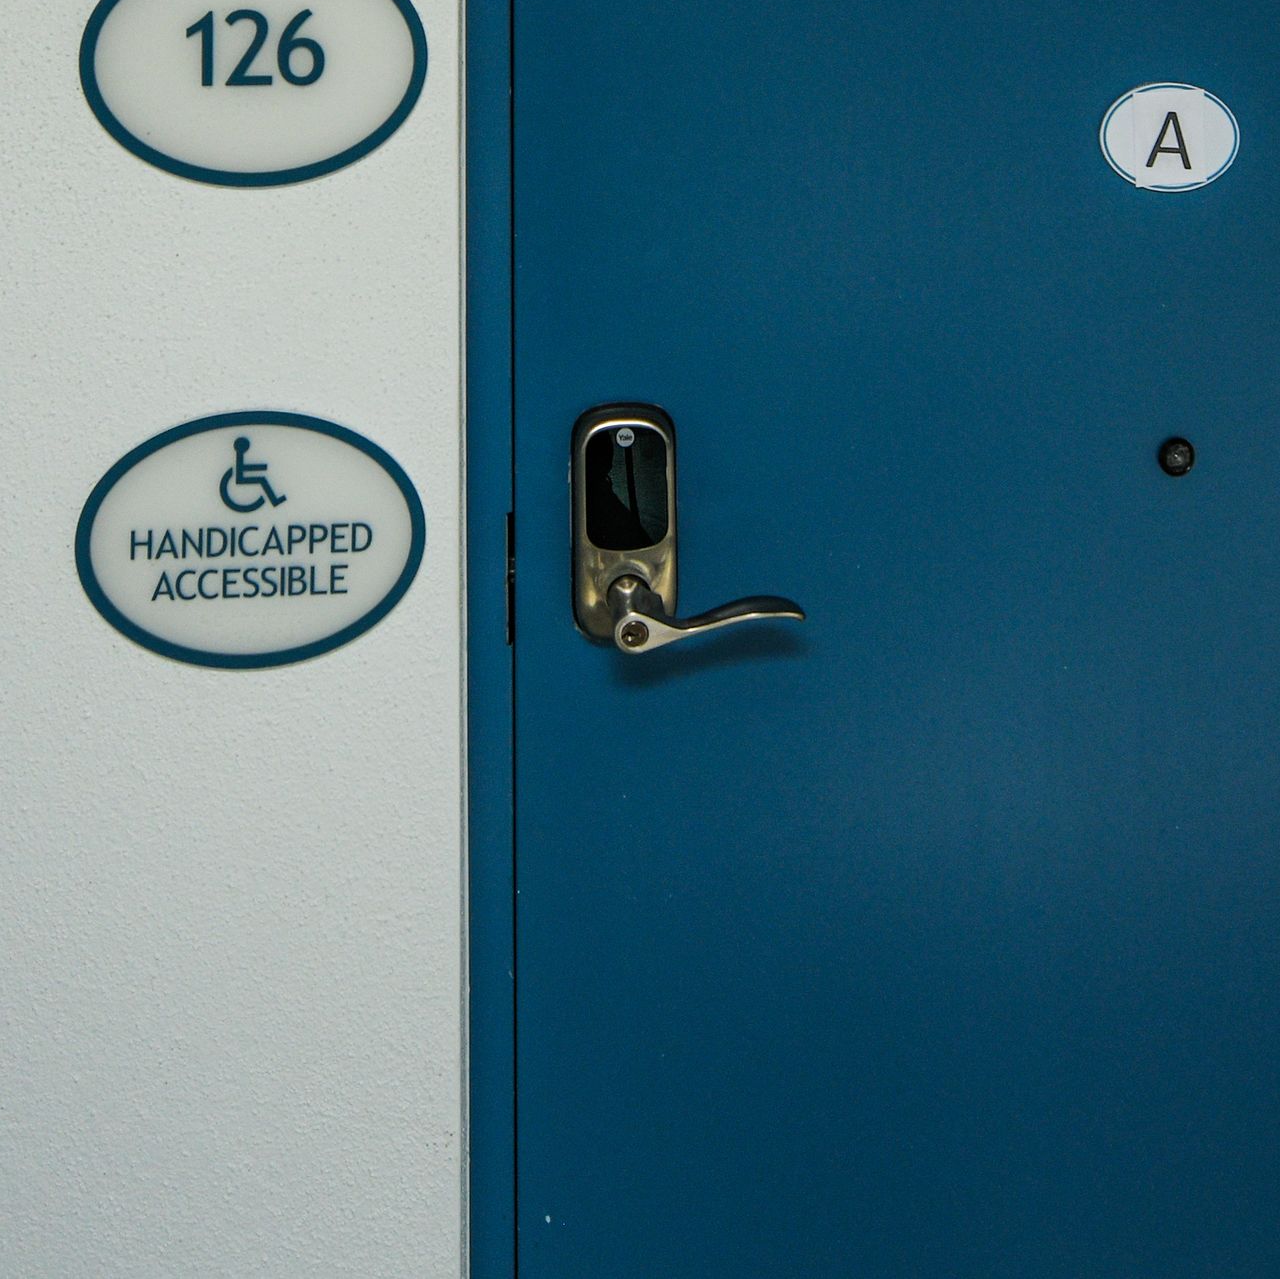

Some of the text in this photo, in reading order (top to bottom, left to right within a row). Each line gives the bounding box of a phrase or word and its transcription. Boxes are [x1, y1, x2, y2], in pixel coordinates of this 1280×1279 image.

[185, 9, 326, 88] 126
[1146, 111, 1192, 170] A
[129, 522, 373, 561] HANDICAPPED
[151, 564, 349, 602] ACCESSIBLE
